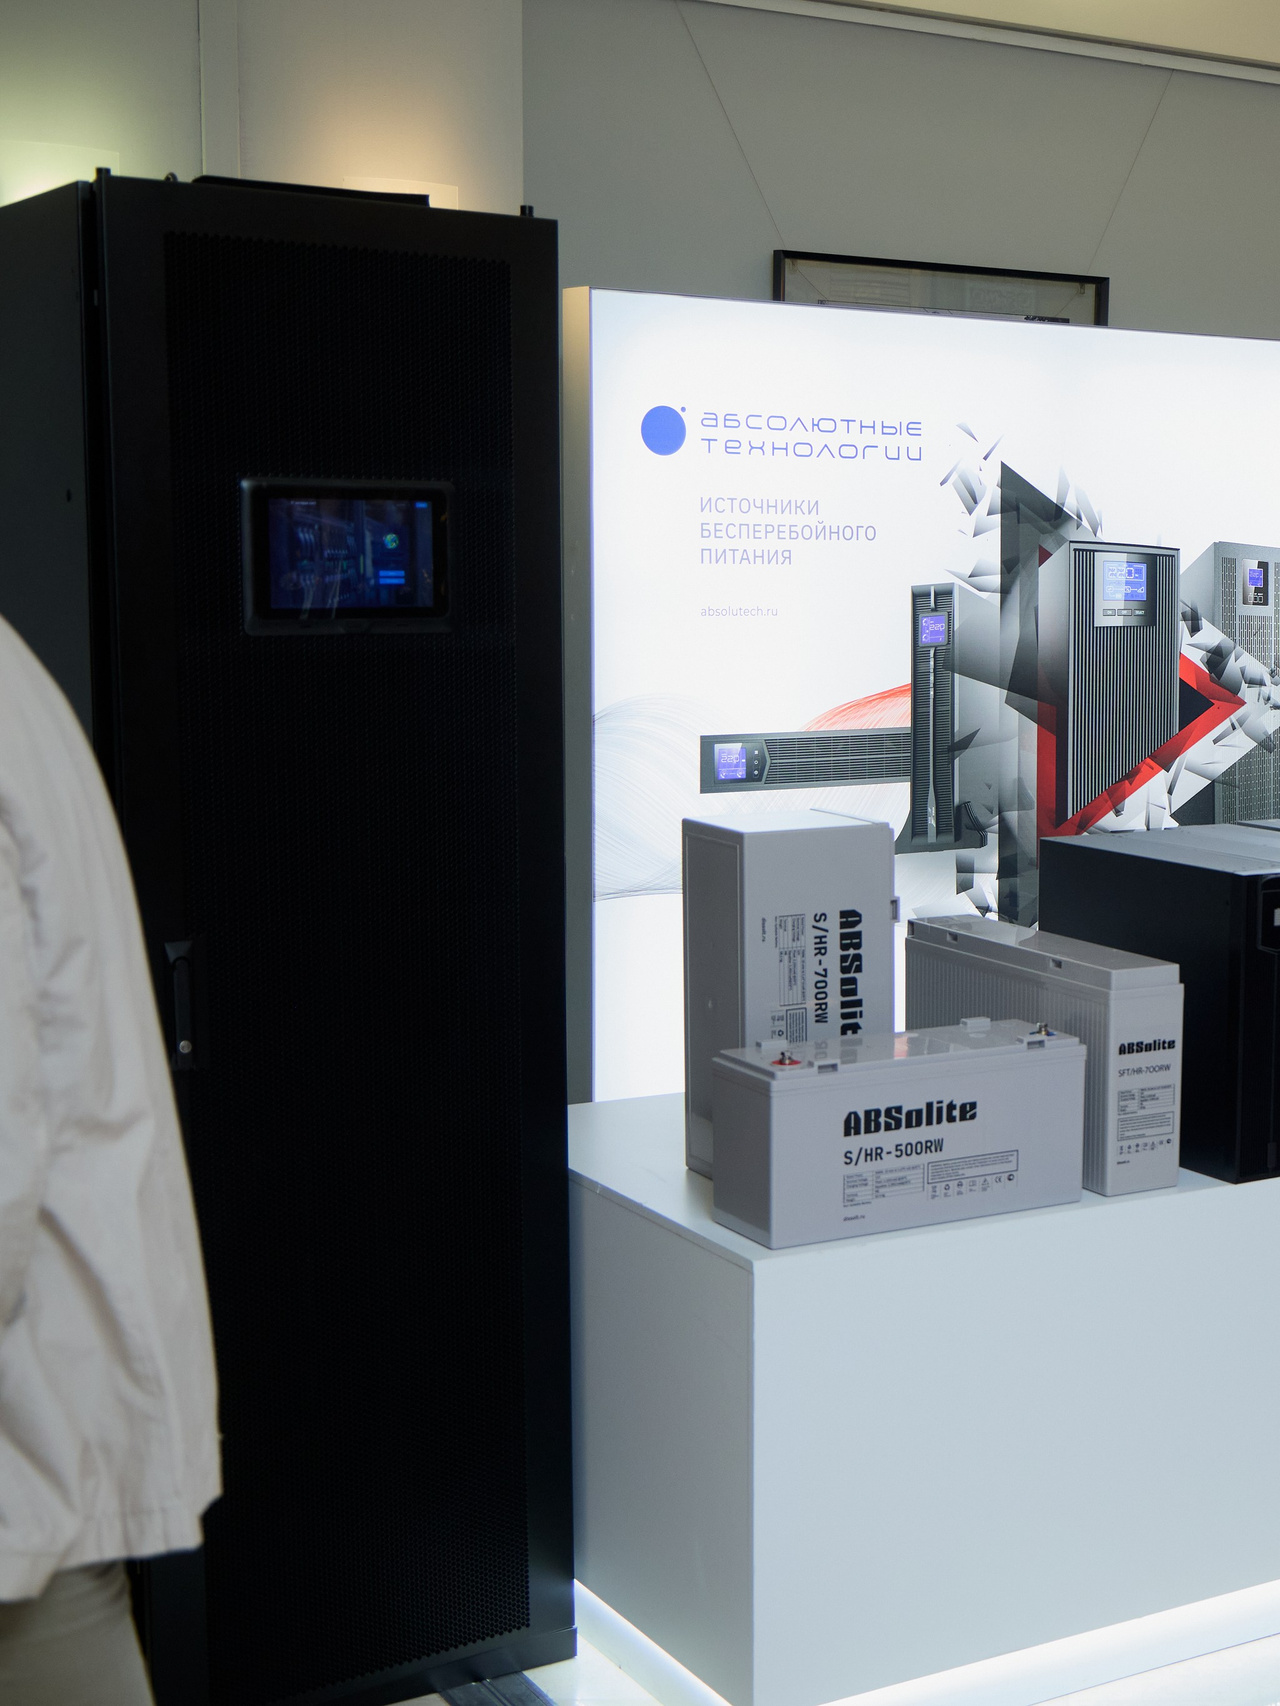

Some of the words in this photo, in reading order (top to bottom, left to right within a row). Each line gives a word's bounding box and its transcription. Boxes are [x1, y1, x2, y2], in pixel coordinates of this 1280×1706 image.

[700, 497, 820, 516] ИСТОЧНИКИ
[700, 521, 877, 541] БЕСПЕРЕБОЙНОГО
[700, 548, 792, 565] ПИТАНИЯ
[700, 606, 779, 617] absolutech.ru
[813, 912, 829, 1024] S/HR-700RW
[839, 908, 863, 1036] ABSolit
[1118, 1039, 1176, 1056] ABSolite
[1118, 1064, 1172, 1078] SFT/HR-700RW
[843, 1099, 977, 1137] ABSolite
[843, 1138, 944, 1166] S/HR-500RW
